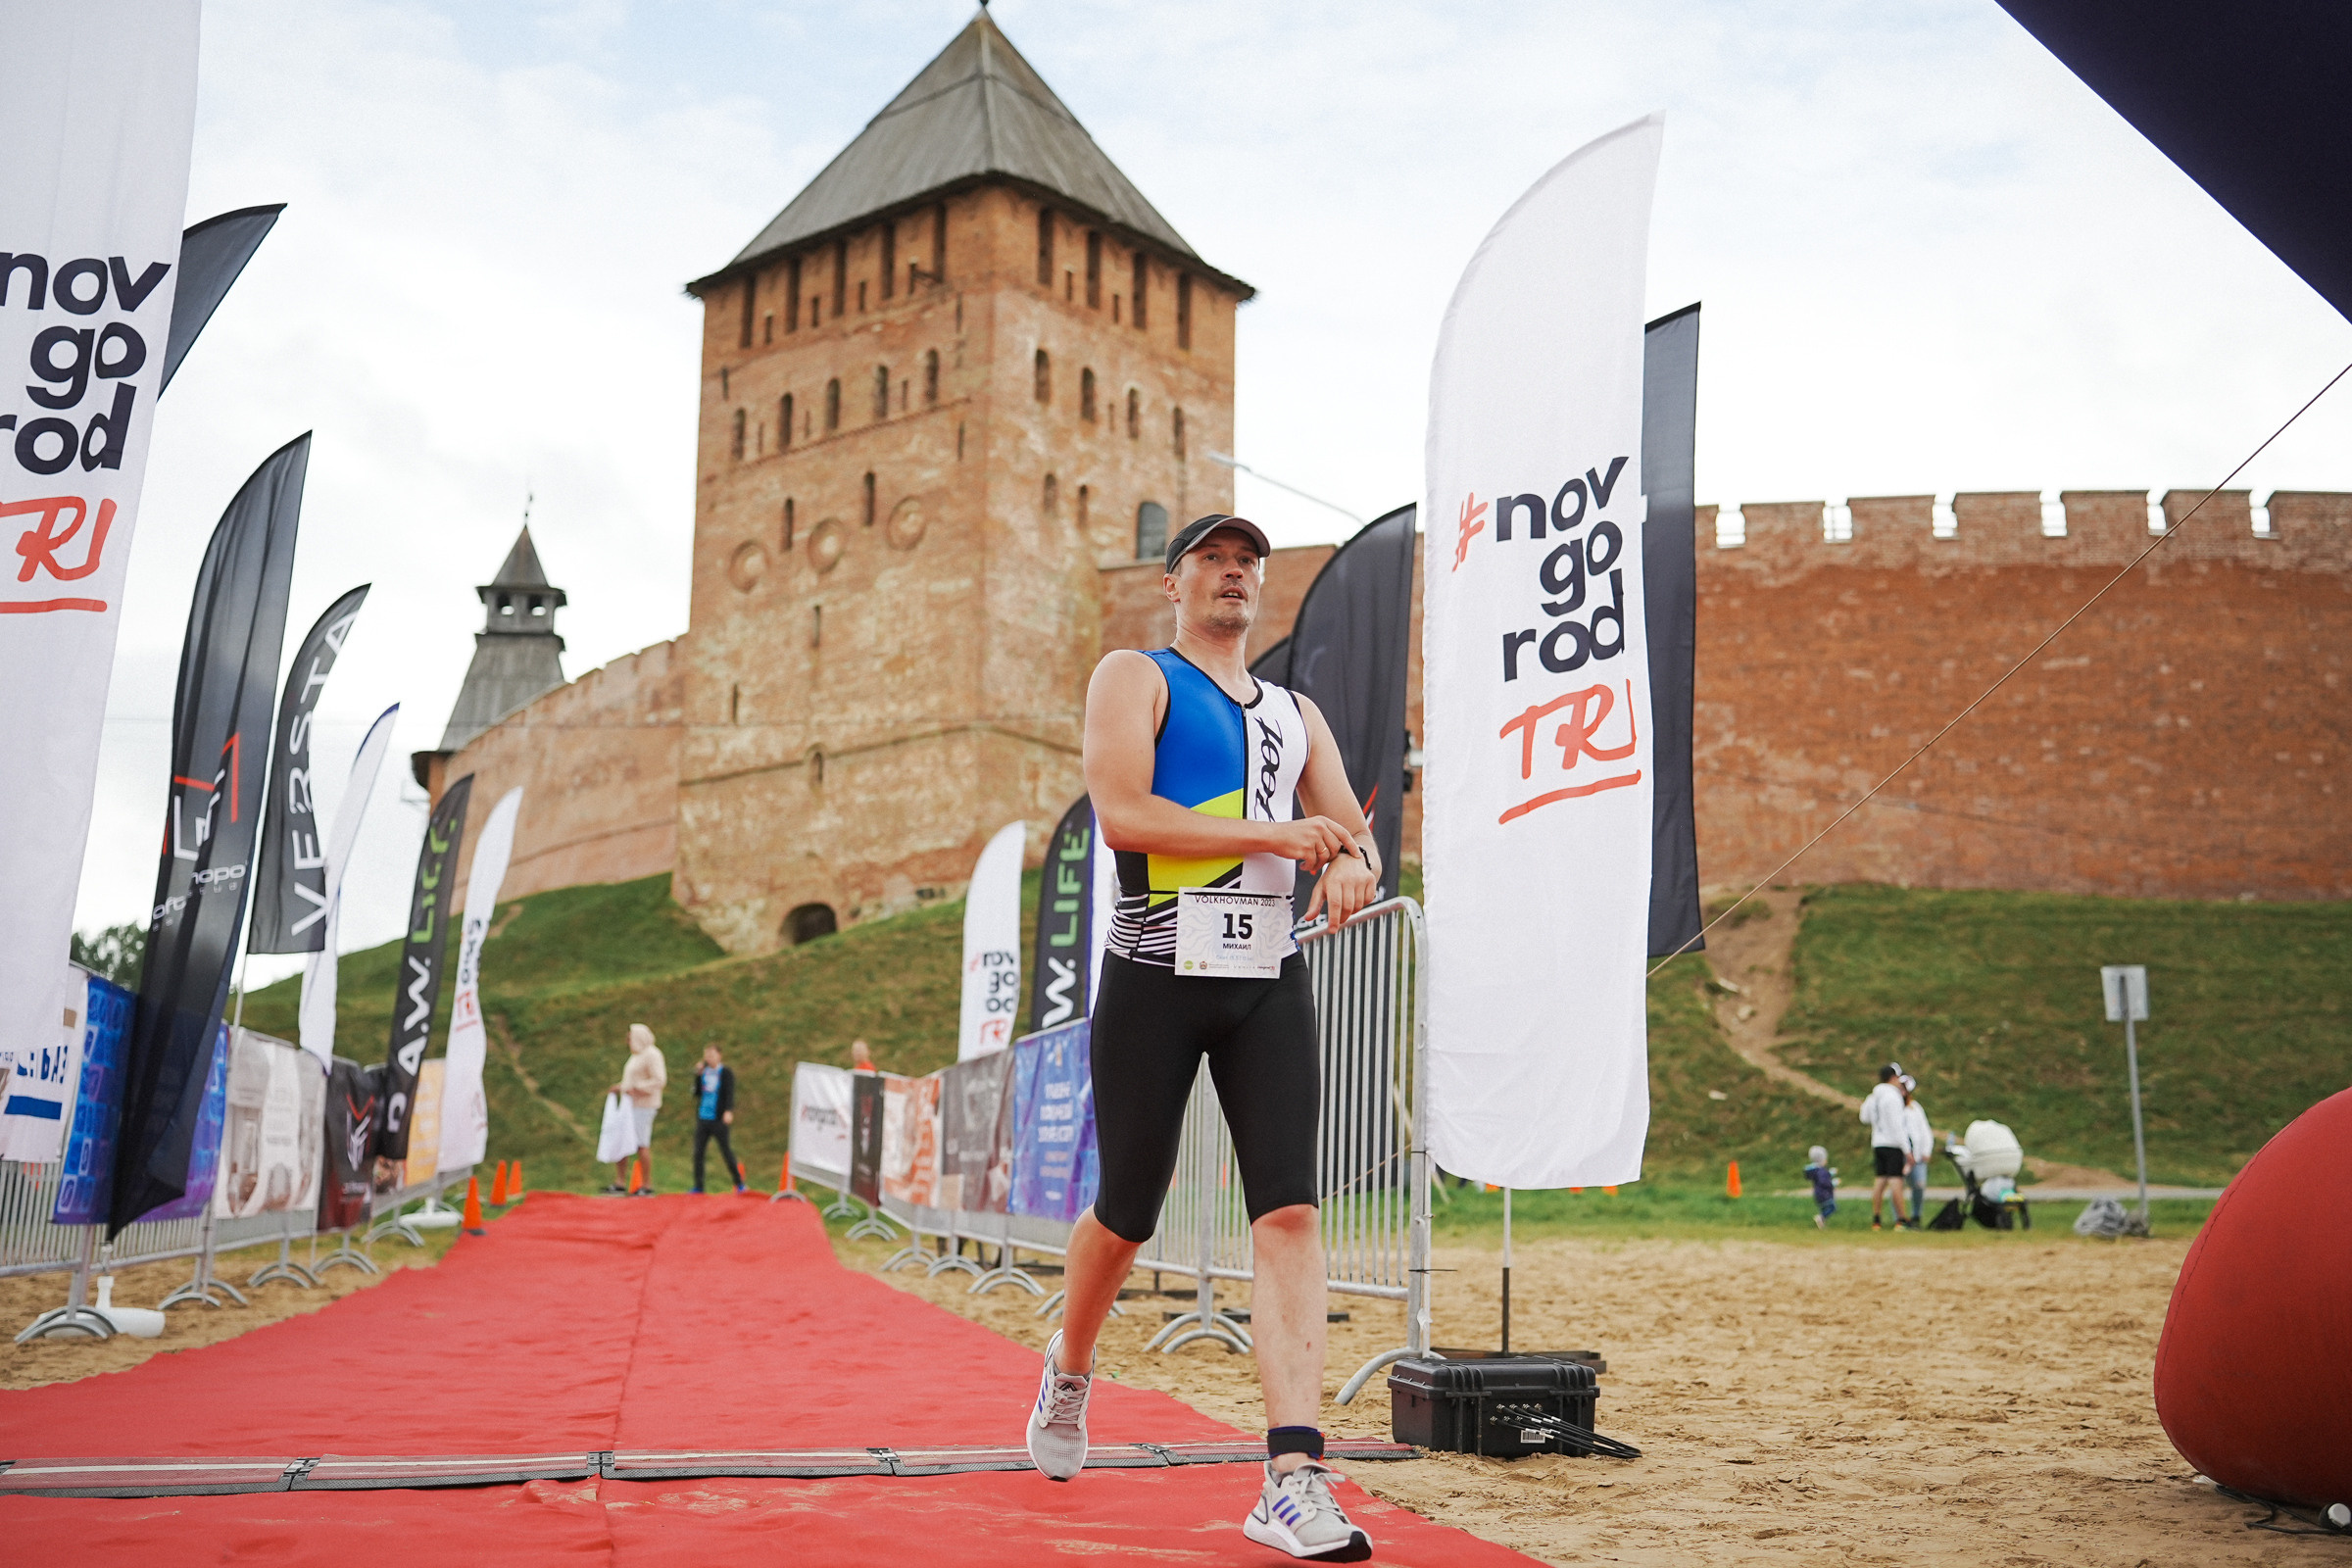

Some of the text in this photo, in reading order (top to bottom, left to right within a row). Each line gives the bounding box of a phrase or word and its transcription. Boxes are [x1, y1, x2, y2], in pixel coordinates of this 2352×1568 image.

[26, 321, 147, 410] go
[1540, 520, 1623, 617] go
[1502, 567, 1625, 682] rod
[288, 609, 360, 938] VERSTA
[1050, 827, 1091, 948] LIFE
[1195, 895, 1259, 906] VOLKHOVMAN
[1222, 912, 1253, 940] 15
